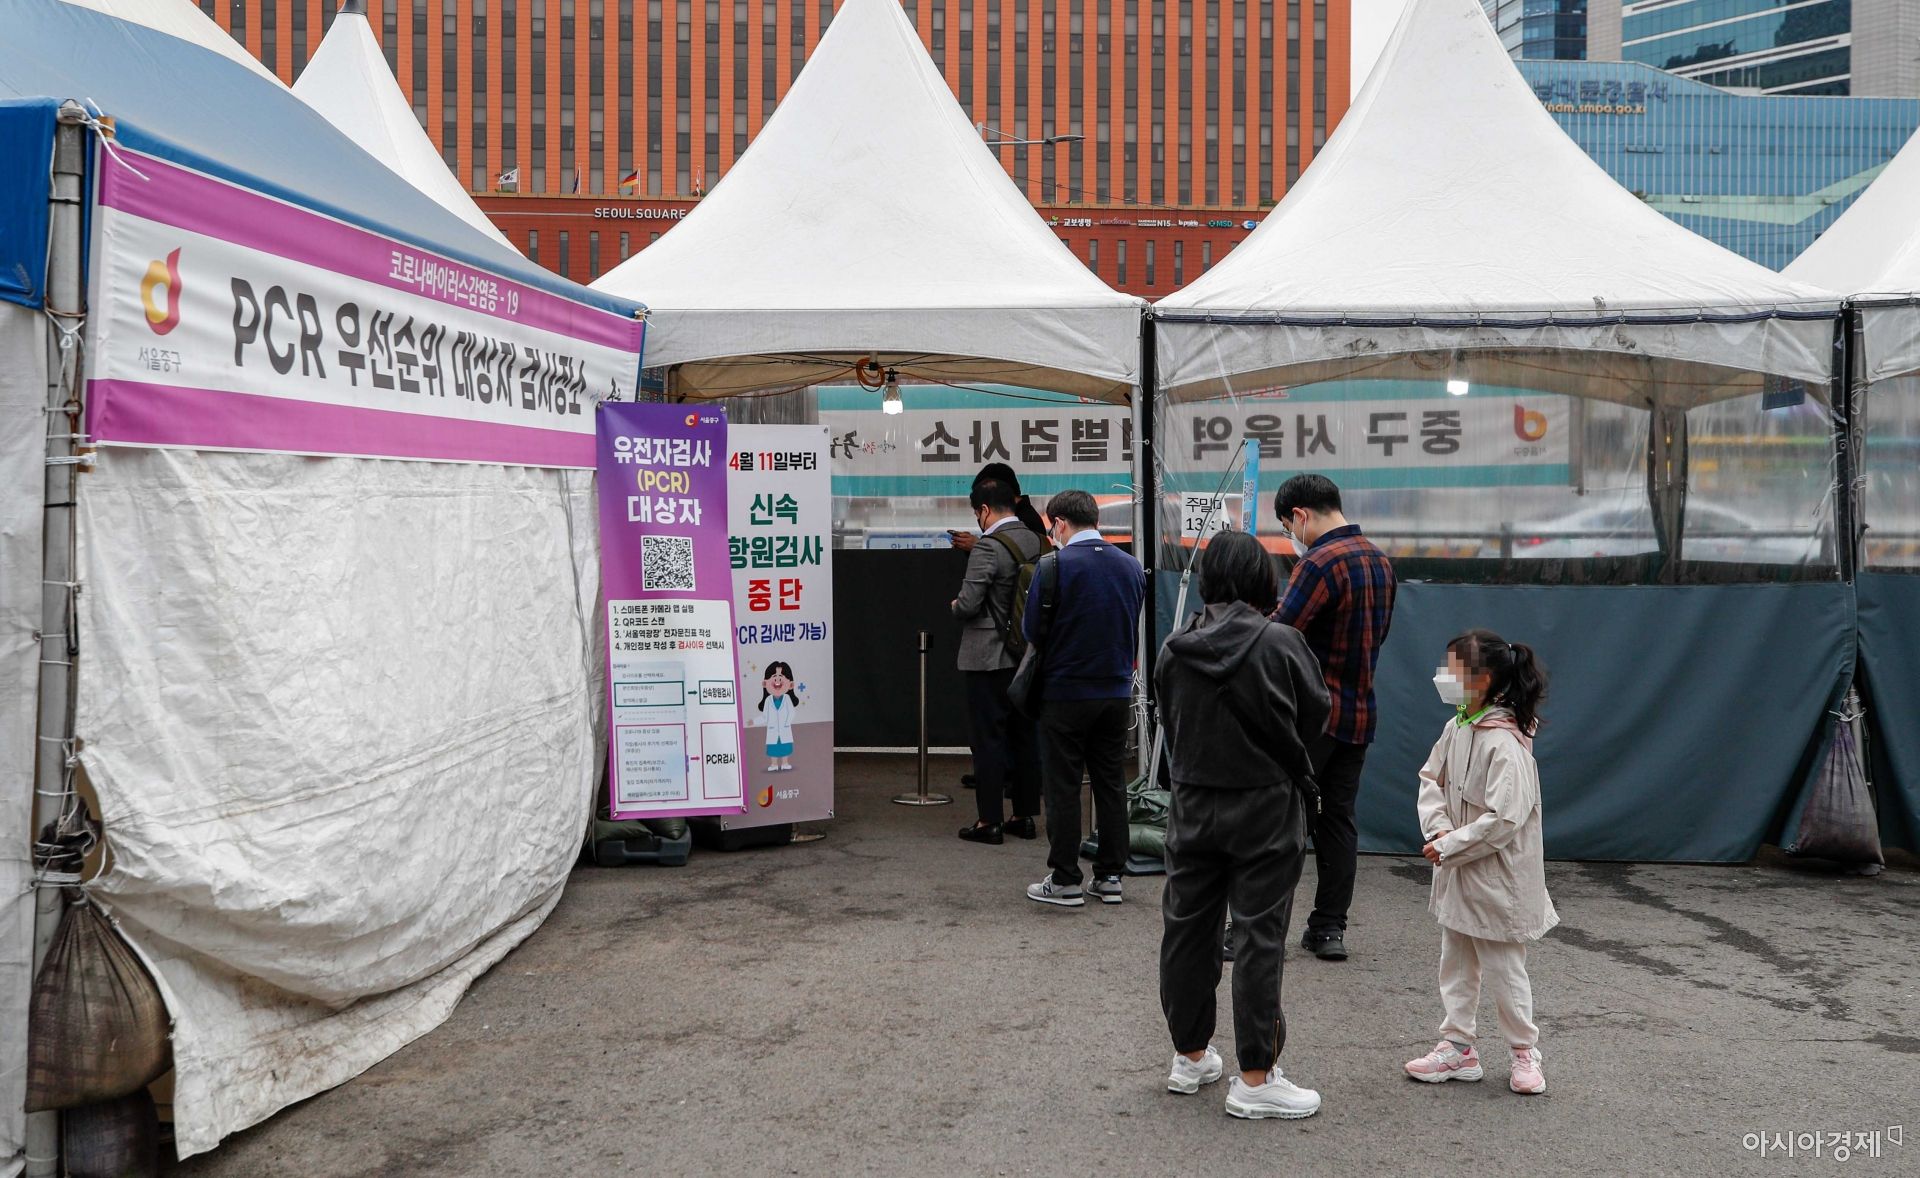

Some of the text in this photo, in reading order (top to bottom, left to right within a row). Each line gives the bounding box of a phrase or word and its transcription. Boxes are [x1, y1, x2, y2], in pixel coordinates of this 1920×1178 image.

[595, 207, 686, 219] SEOUL SQUARE
[1063, 218, 1092, 227] 교보생명
[231, 277, 587, 415] PCR 우선순위 대상자 검사장소
[138, 346, 182, 373] 서울중구
[700, 416, 720, 424] 서울중구
[614, 436, 711, 467] 유전자검사
[729, 452, 817, 471] 4월 11일부터
[637, 468, 690, 494] (PCR)
[628, 495, 702, 525] 대상자
[750, 493, 798, 525] 신속
[729, 536, 823, 569] 항원검사
[613, 606, 619, 614] 1.
[621, 605, 648, 614] 스마트폰
[650, 605, 671, 613] 카메라
[614, 618, 621, 626] 2.
[622, 618, 649, 626] QR코드
[614, 630, 622, 639] 3.
[664, 629, 697, 637] 전자문진표
[761, 624, 796, 643] 검사만
[799, 622, 826, 641] 가능)
[615, 640, 725, 651] 4. 개인정보 작성 후 검사이유 선택시
[706, 753, 735, 764] PCR검사
[776, 788, 799, 800] 서울중구
